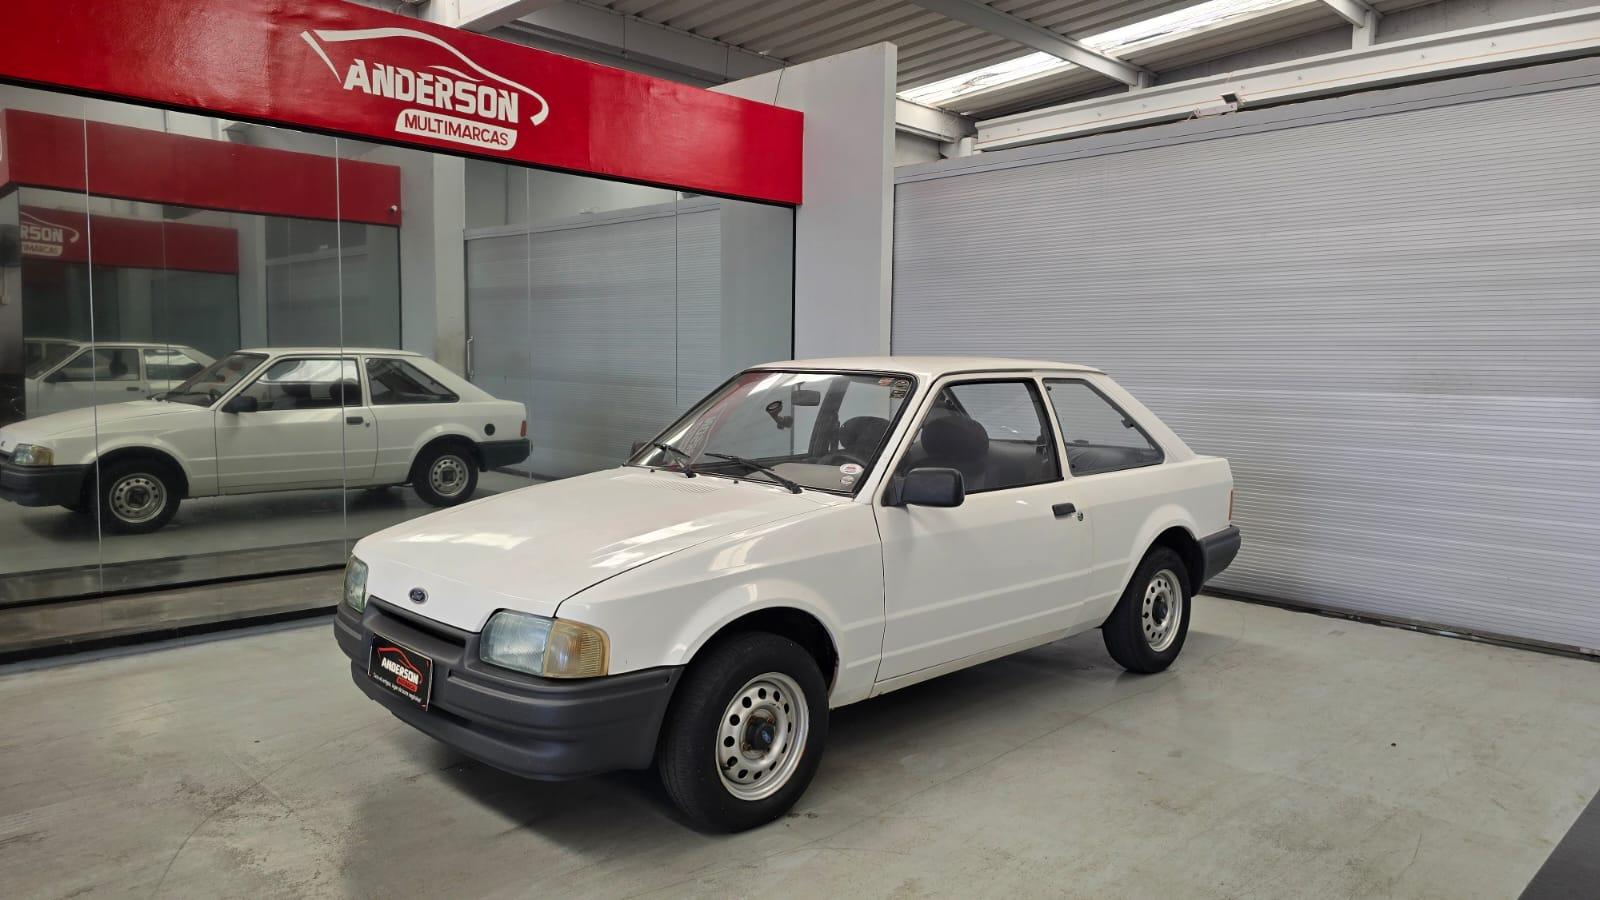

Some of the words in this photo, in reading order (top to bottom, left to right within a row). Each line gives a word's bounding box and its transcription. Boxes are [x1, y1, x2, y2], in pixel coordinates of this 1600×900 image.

[343, 59, 518, 123] ANDERSON
[404, 113, 508, 146] MULTIMARCAS
[20, 225, 63, 242] RSON
[381, 657, 419, 685] ANDERSON
